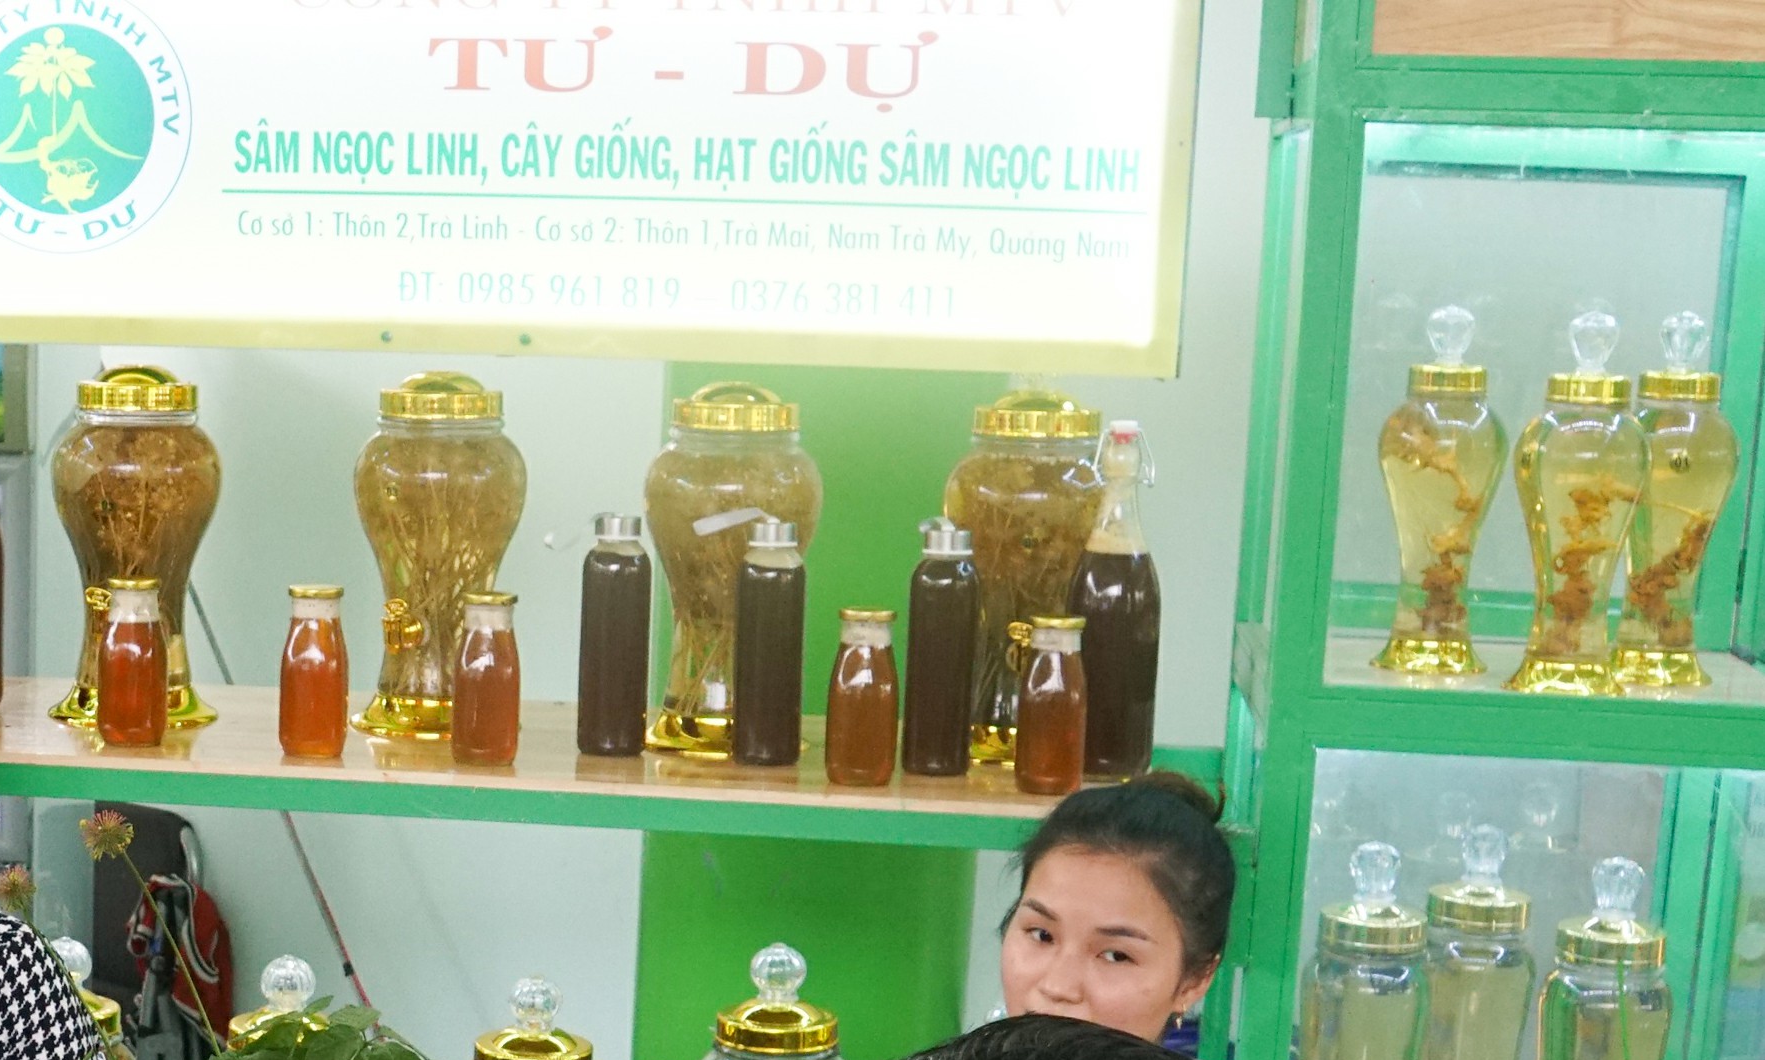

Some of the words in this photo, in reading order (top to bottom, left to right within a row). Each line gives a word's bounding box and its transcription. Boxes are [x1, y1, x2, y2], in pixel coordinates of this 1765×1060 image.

[149, 55, 180, 135] MTV
[428, 26, 614, 93] TƯ
[732, 30, 940, 113] DỰ
[233, 117, 300, 174] SÂM
[312, 130, 395, 184] NGỌC
[407, 132, 489, 185] LINH,
[500, 121, 564, 178] CÂY
[574, 116, 680, 190] GIỐNG,
[693, 137, 757, 192] HẠT
[768, 121, 868, 185] GIỐNG
[878, 128, 951, 187] SÂM
[963, 143, 1052, 200] NGỌC
[1064, 146, 1142, 192] LINH
[82, 200, 137, 241] DỰ
[237, 210, 263, 236] Cơ
[305, 210, 323, 237] 1:
[332, 211, 385, 237] Thôn
[462, 214, 508, 240] Linh
[535, 215, 561, 242] Cơ
[604, 217, 624, 243] 2:
[635, 217, 689, 245] Thôn
[768, 221, 816, 253] Mai,
[828, 223, 880, 250] Nam
[889, 224, 926, 252] Trà
[936, 226, 977, 260] My,
[989, 227, 1066, 263] Quảng
[1077, 231, 1130, 258] Nam
[458, 272, 535, 304] 0985
[550, 274, 602, 306] 961
[621, 275, 681, 308] 819
[731, 279, 809, 313] 0376
[825, 282, 879, 315] 381
[898, 285, 955, 318] 411
